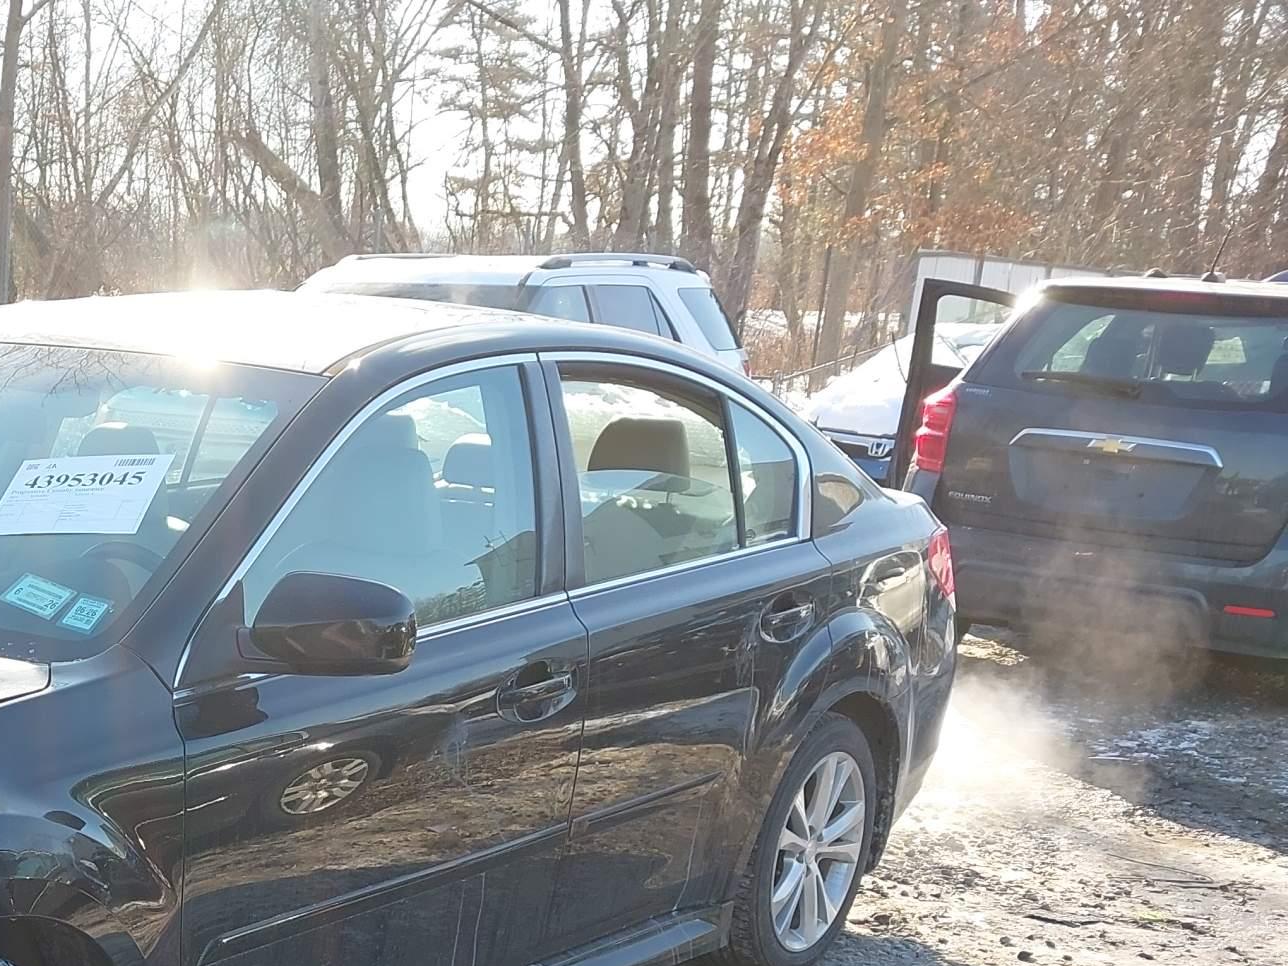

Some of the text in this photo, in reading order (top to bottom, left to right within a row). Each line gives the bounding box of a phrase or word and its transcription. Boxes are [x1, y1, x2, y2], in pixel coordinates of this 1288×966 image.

[24, 471, 147, 489] 43953045
[948, 490, 992, 504] EQUINOX
[43, 599, 59, 610] 26
